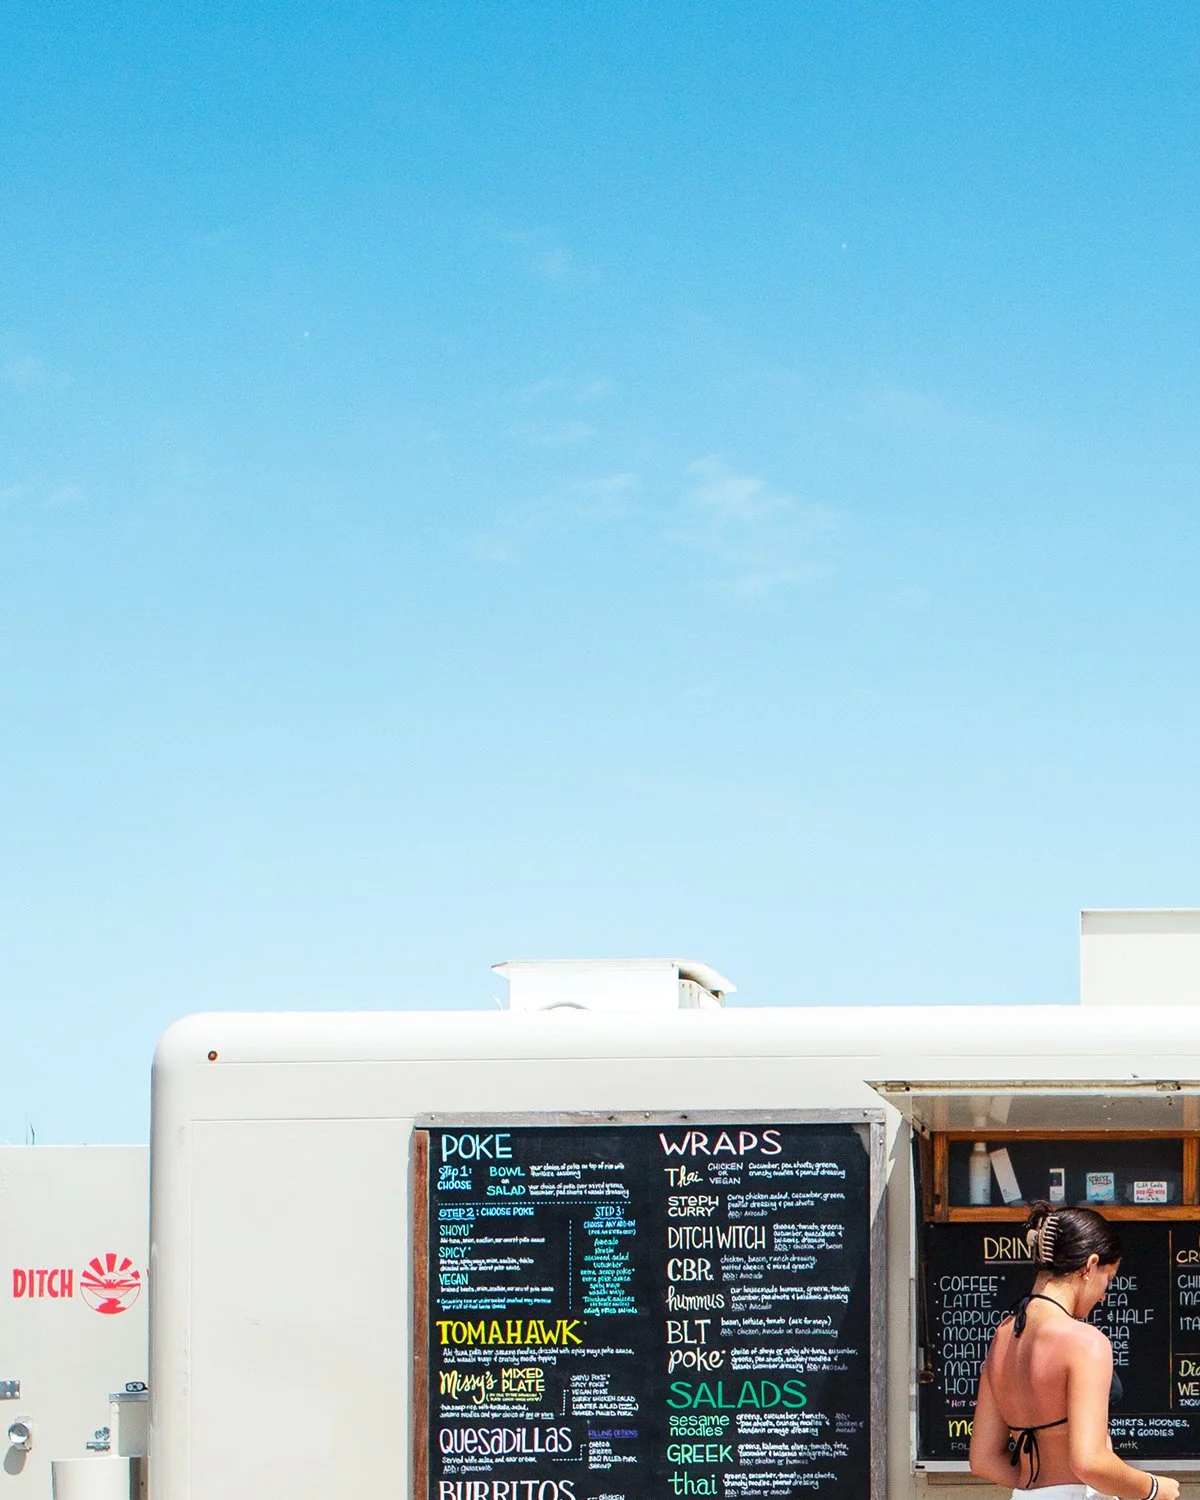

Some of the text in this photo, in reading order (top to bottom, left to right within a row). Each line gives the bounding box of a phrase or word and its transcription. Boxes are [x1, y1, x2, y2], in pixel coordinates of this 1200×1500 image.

[441, 1133, 513, 1162] POKE
[658, 1129, 782, 1156] WRAPS
[489, 1166, 526, 1177] BOWL
[707, 1162, 744, 1171] CHICKEN
[664, 1165, 704, 1188] Thai
[709, 1177, 741, 1185] VEGAN
[437, 1181, 472, 1190] CHOOSE
[486, 1185, 526, 1196] SALAD
[438, 1208, 466, 1218] STEP
[480, 1207, 512, 1216] CHOOSE
[512, 1206, 535, 1216] POKE
[595, 1206, 615, 1217] STEP
[667, 1206, 715, 1217] CURRY
[668, 1226, 713, 1249] DITCH
[716, 1226, 766, 1249] WITCH
[983, 1237, 1032, 1260] DRIN
[12, 1268, 74, 1299] DITCH
[438, 1273, 469, 1285] VEGAN
[1109, 1276, 1138, 1290] ADE
[665, 1285, 725, 1312] hummus
[941, 1310, 1011, 1326] CAPPUCC
[1116, 1308, 1154, 1324] HALF
[666, 1318, 711, 1344] BLT
[942, 1342, 982, 1359] CHAI
[501, 1367, 544, 1379] MIXED
[943, 1360, 985, 1377] MAT
[439, 1369, 498, 1404] Missy's
[501, 1379, 546, 1392] PLATE
[944, 1378, 979, 1395] HOT
[1177, 1382, 1200, 1396] WE
[666, 1379, 808, 1409] SALADS
[668, 1415, 730, 1427] sesame
[670, 1425, 724, 1437] noodles
[1137, 1428, 1174, 1437] GOODIES
[951, 1442, 970, 1450] FOL
[666, 1443, 734, 1465] GREEK
[667, 1471, 718, 1495] thai
